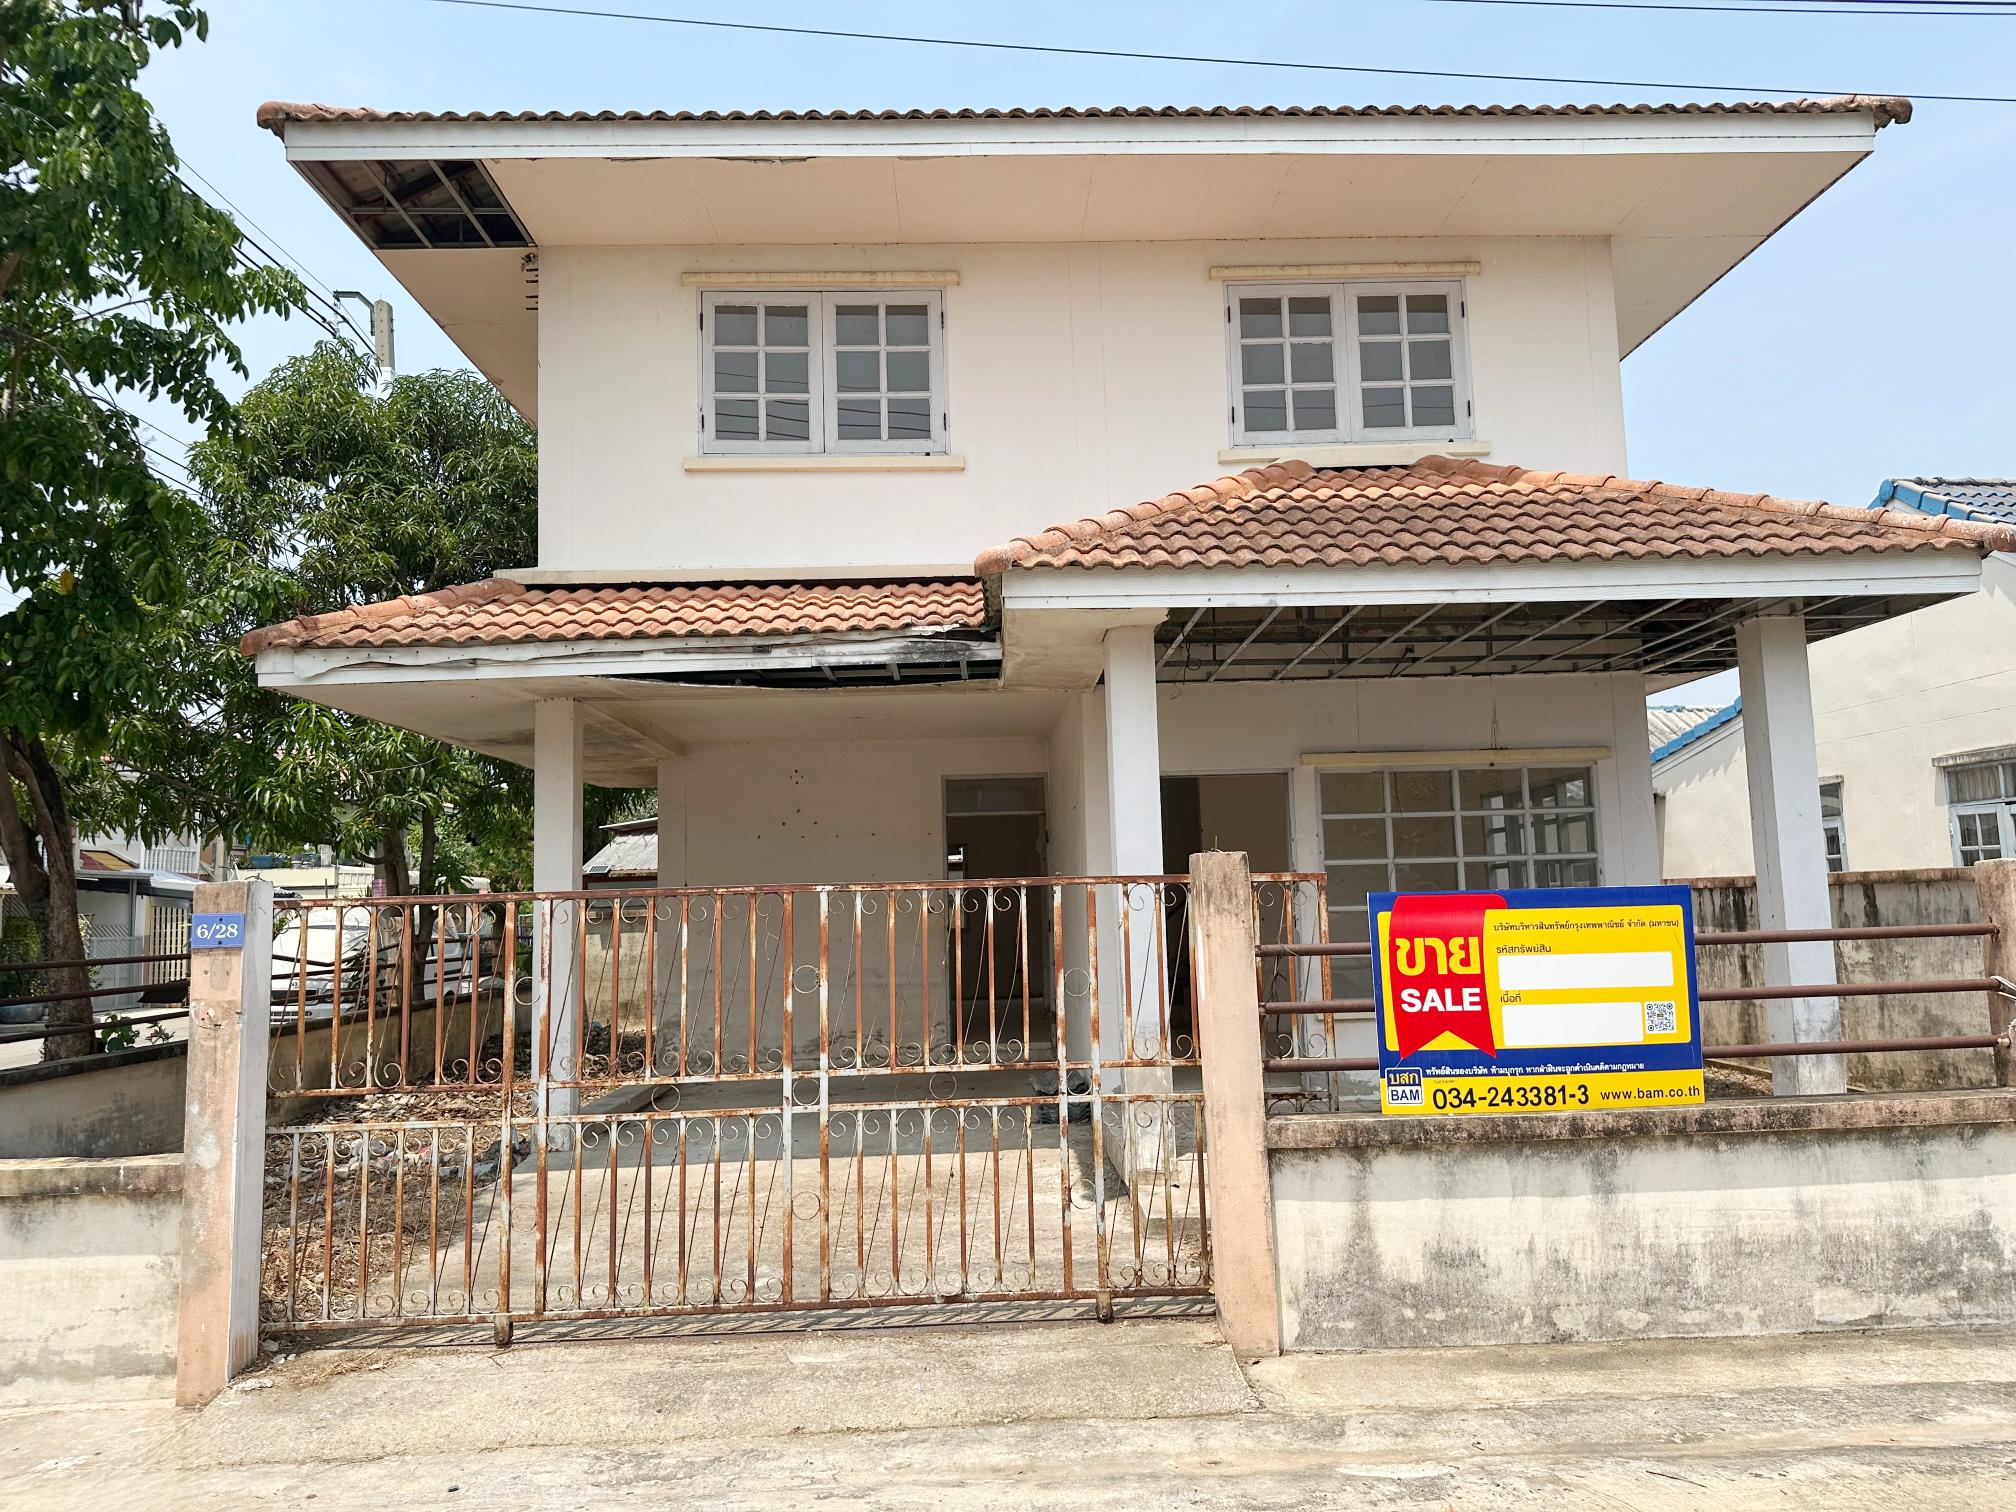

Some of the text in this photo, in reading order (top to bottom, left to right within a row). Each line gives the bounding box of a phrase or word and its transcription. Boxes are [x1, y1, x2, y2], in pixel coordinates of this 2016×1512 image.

[1628, 918, 1646, 928] จำกัด
[1649, 919, 1679, 929] (มหาชน)
[197, 923, 238, 940] 6/28
[1496, 943, 1552, 954] รหัสทรัพย์สิน
[1396, 936, 1481, 976] ขาย
[1400, 988, 1482, 1013] SALE
[1500, 990, 1522, 1003] เนื้อที่
[1389, 1073, 1419, 1085] บสก
[1390, 1089, 1420, 1102] BAM
[1432, 1084, 1700, 1109] 034-243381-3 www.bam.co.th
